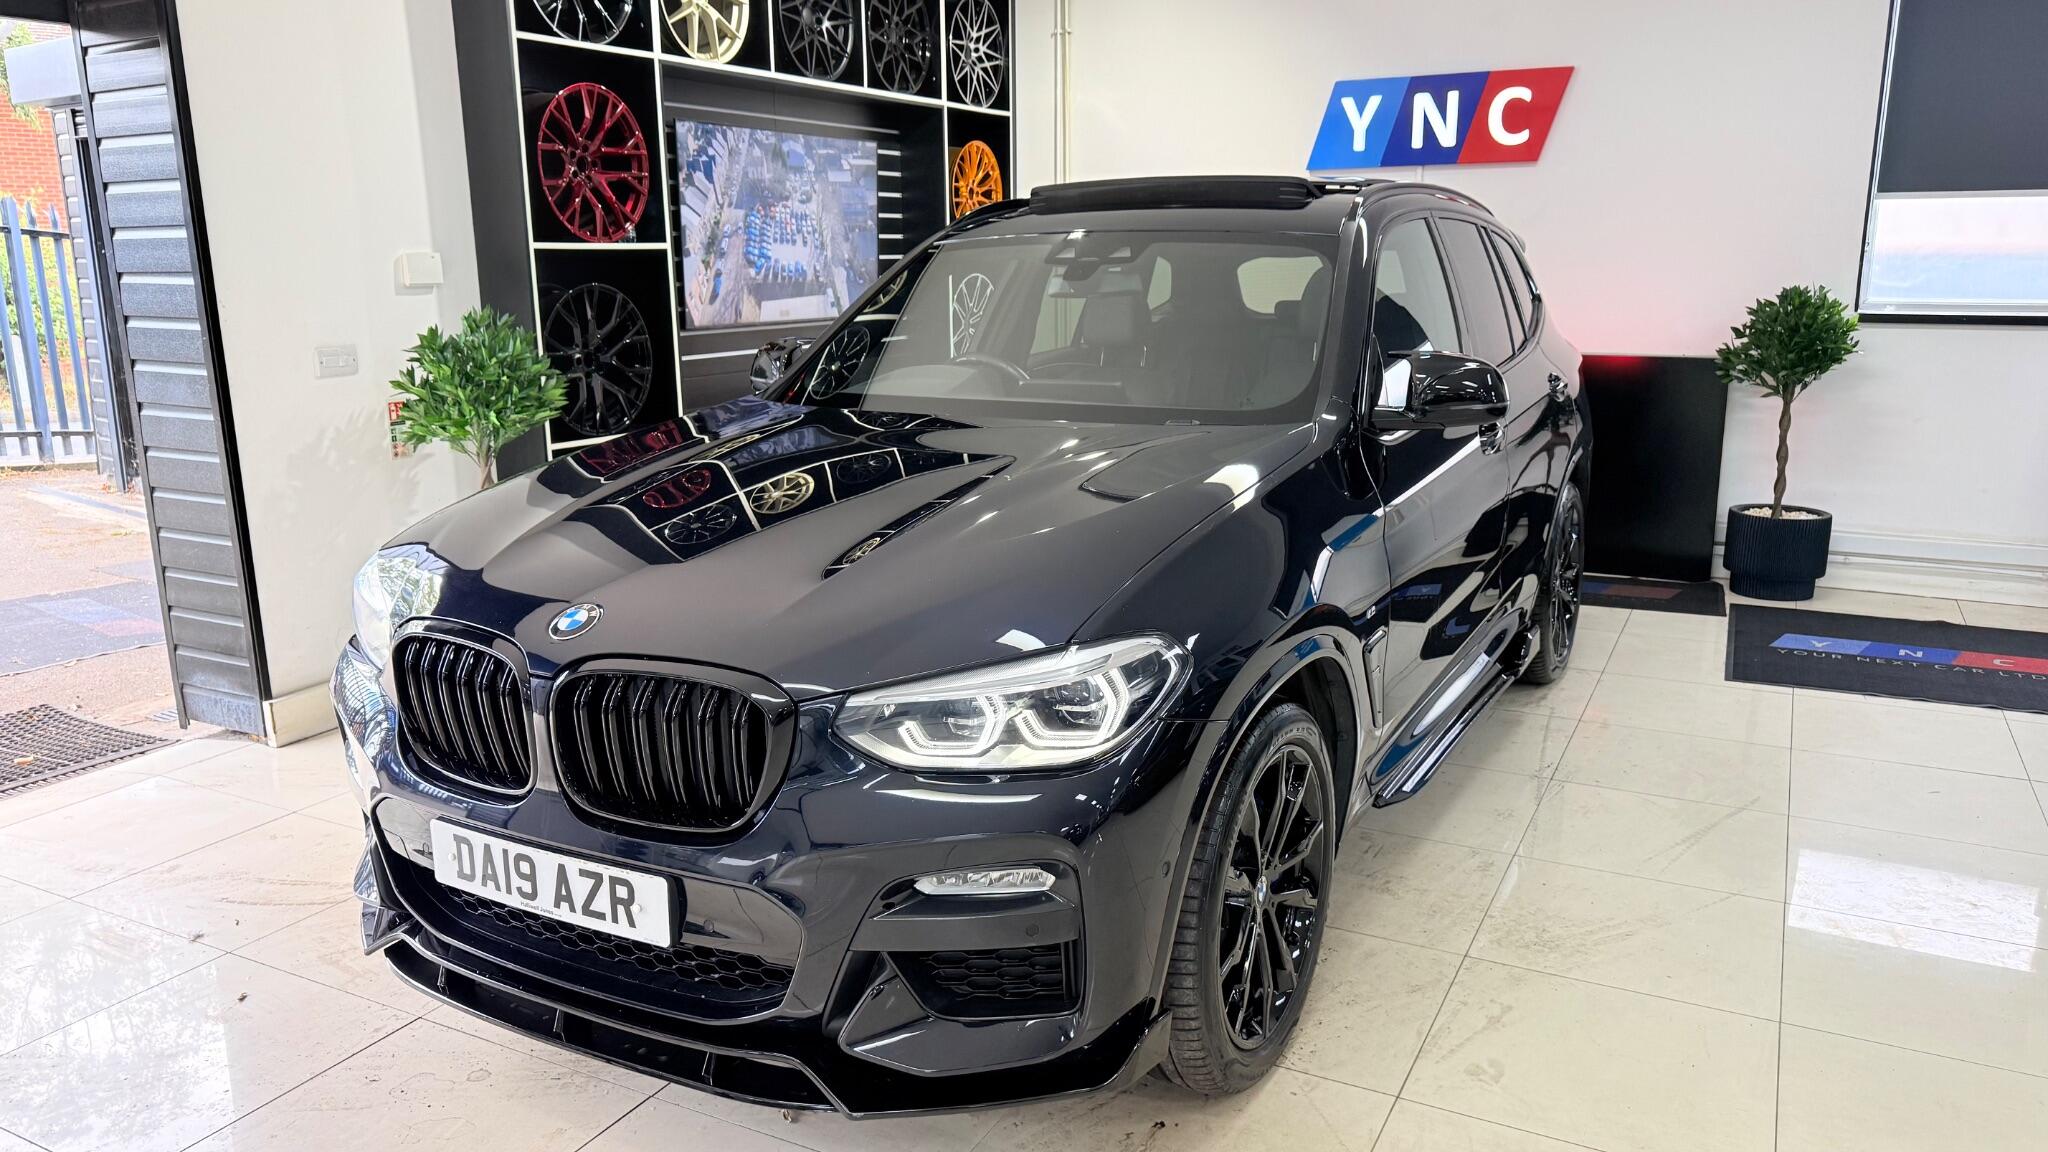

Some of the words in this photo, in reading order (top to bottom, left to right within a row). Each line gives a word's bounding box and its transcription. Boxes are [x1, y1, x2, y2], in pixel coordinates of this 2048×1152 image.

[1341, 86, 1532, 152] YNC
[1777, 648, 1842, 659] YOUR
[1856, 656, 1920, 668] NEXT
[1934, 664, 1984, 674] CAR
[1999, 671, 2047, 680] LTD
[1809, 640, 2015, 667] YNC
[453, 833, 538, 902] DA19
[553, 863, 637, 929] AZR
